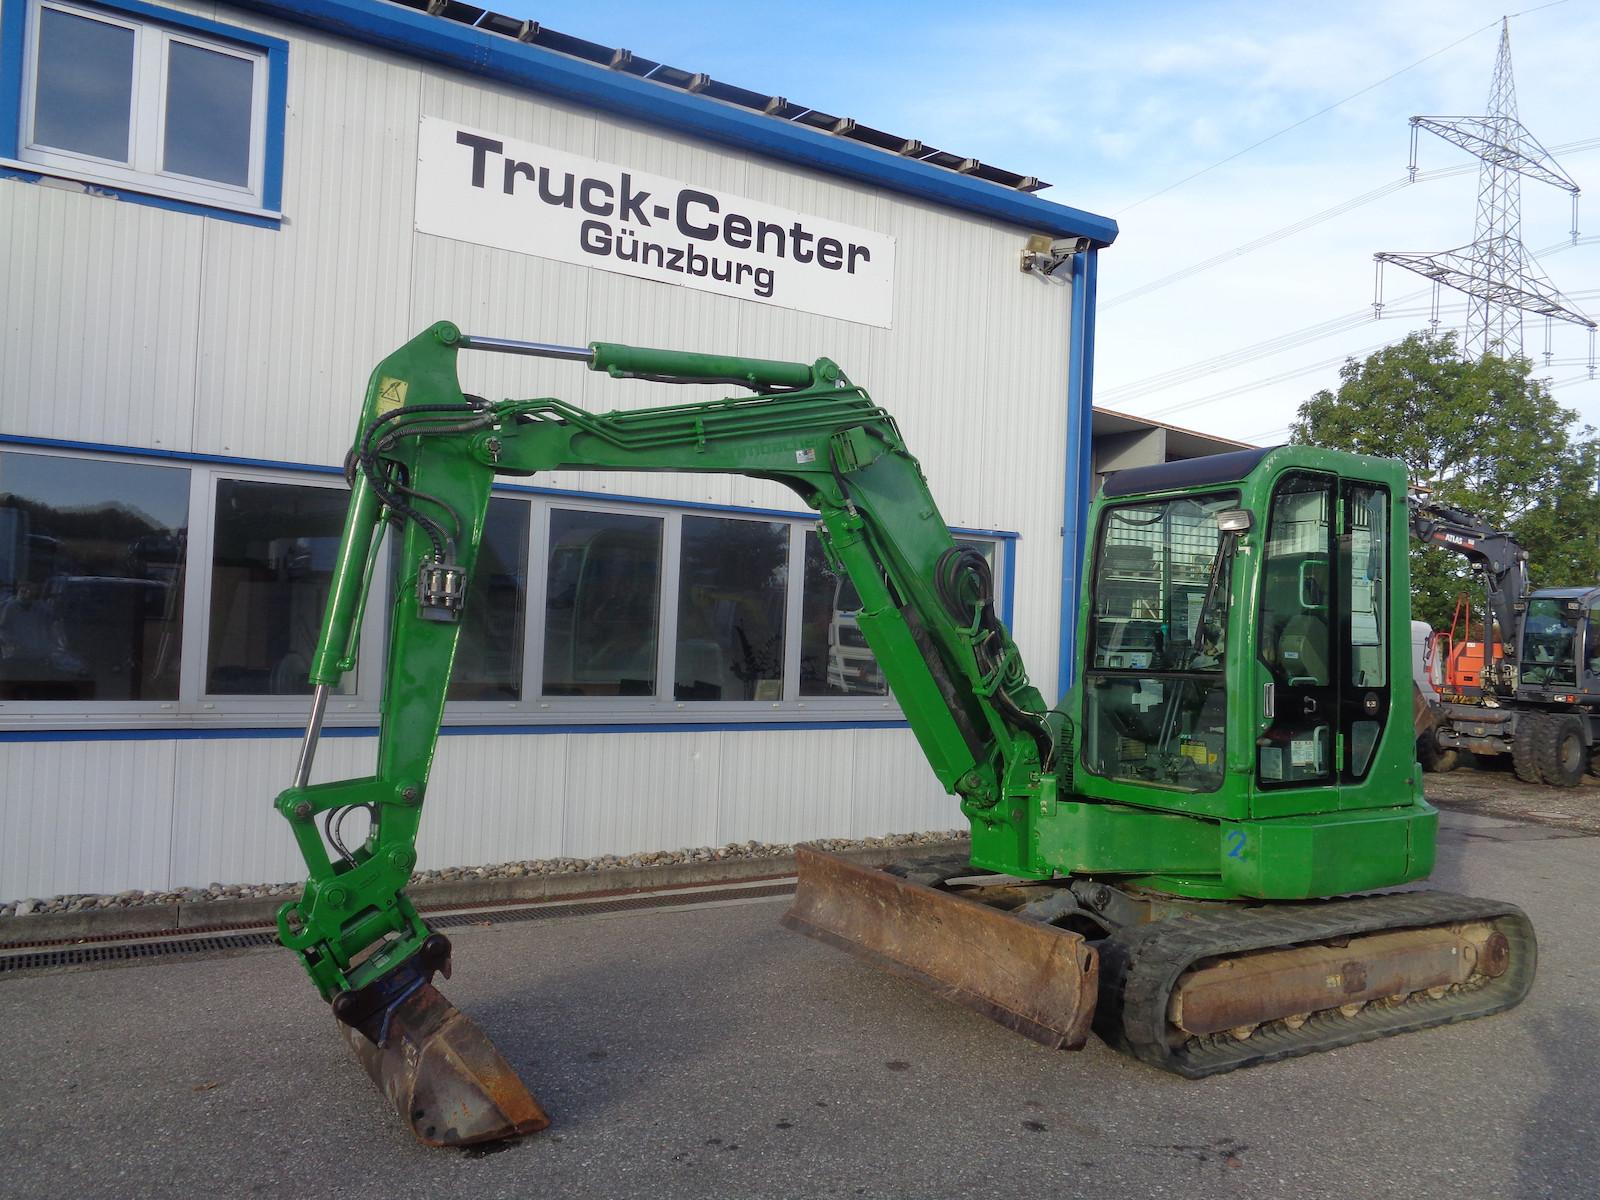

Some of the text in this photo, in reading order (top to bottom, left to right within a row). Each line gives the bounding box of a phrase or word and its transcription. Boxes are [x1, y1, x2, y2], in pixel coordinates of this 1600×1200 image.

[456, 130, 871, 275] Truck-Center
[580, 219, 775, 298] Günzburg
[1227, 830, 1248, 863] 2
